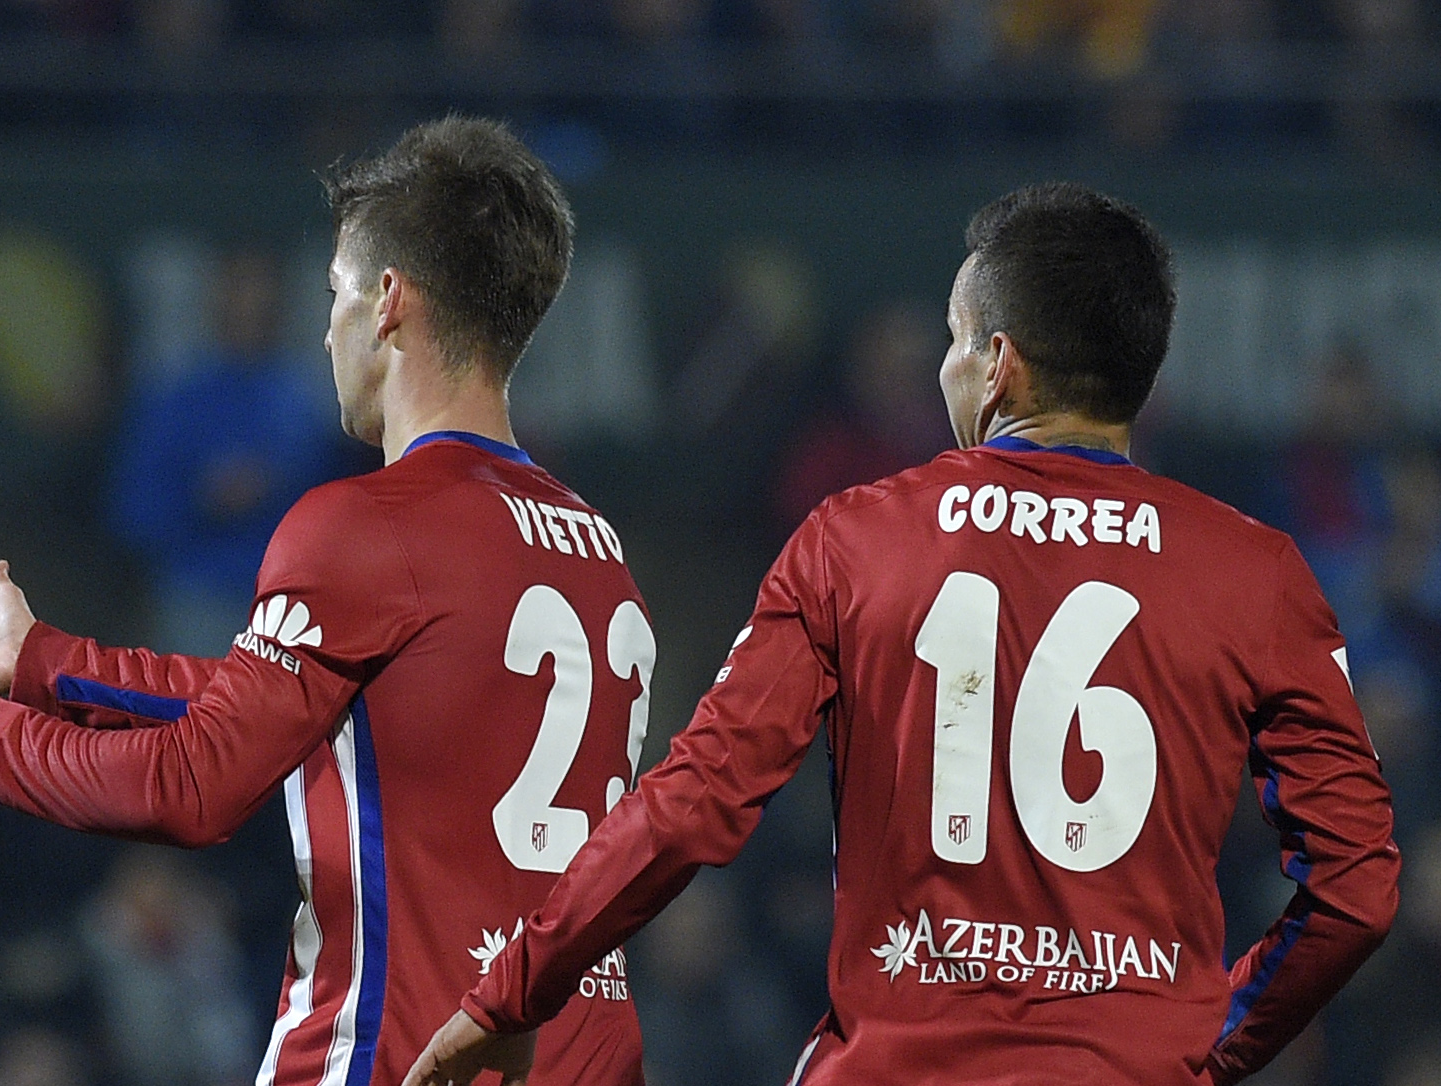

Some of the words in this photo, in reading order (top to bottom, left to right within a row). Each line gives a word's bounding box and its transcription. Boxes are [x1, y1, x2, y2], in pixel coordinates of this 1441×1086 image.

[500, 492, 624, 565] VIETTO
[938, 485, 1161, 553] CORREA
[914, 571, 1157, 872] 16
[909, 908, 1181, 990] AZERBAIJAN
[919, 961, 987, 984] LAND
[997, 964, 1035, 983] OF
[1043, 970, 1105, 993] FIRE
